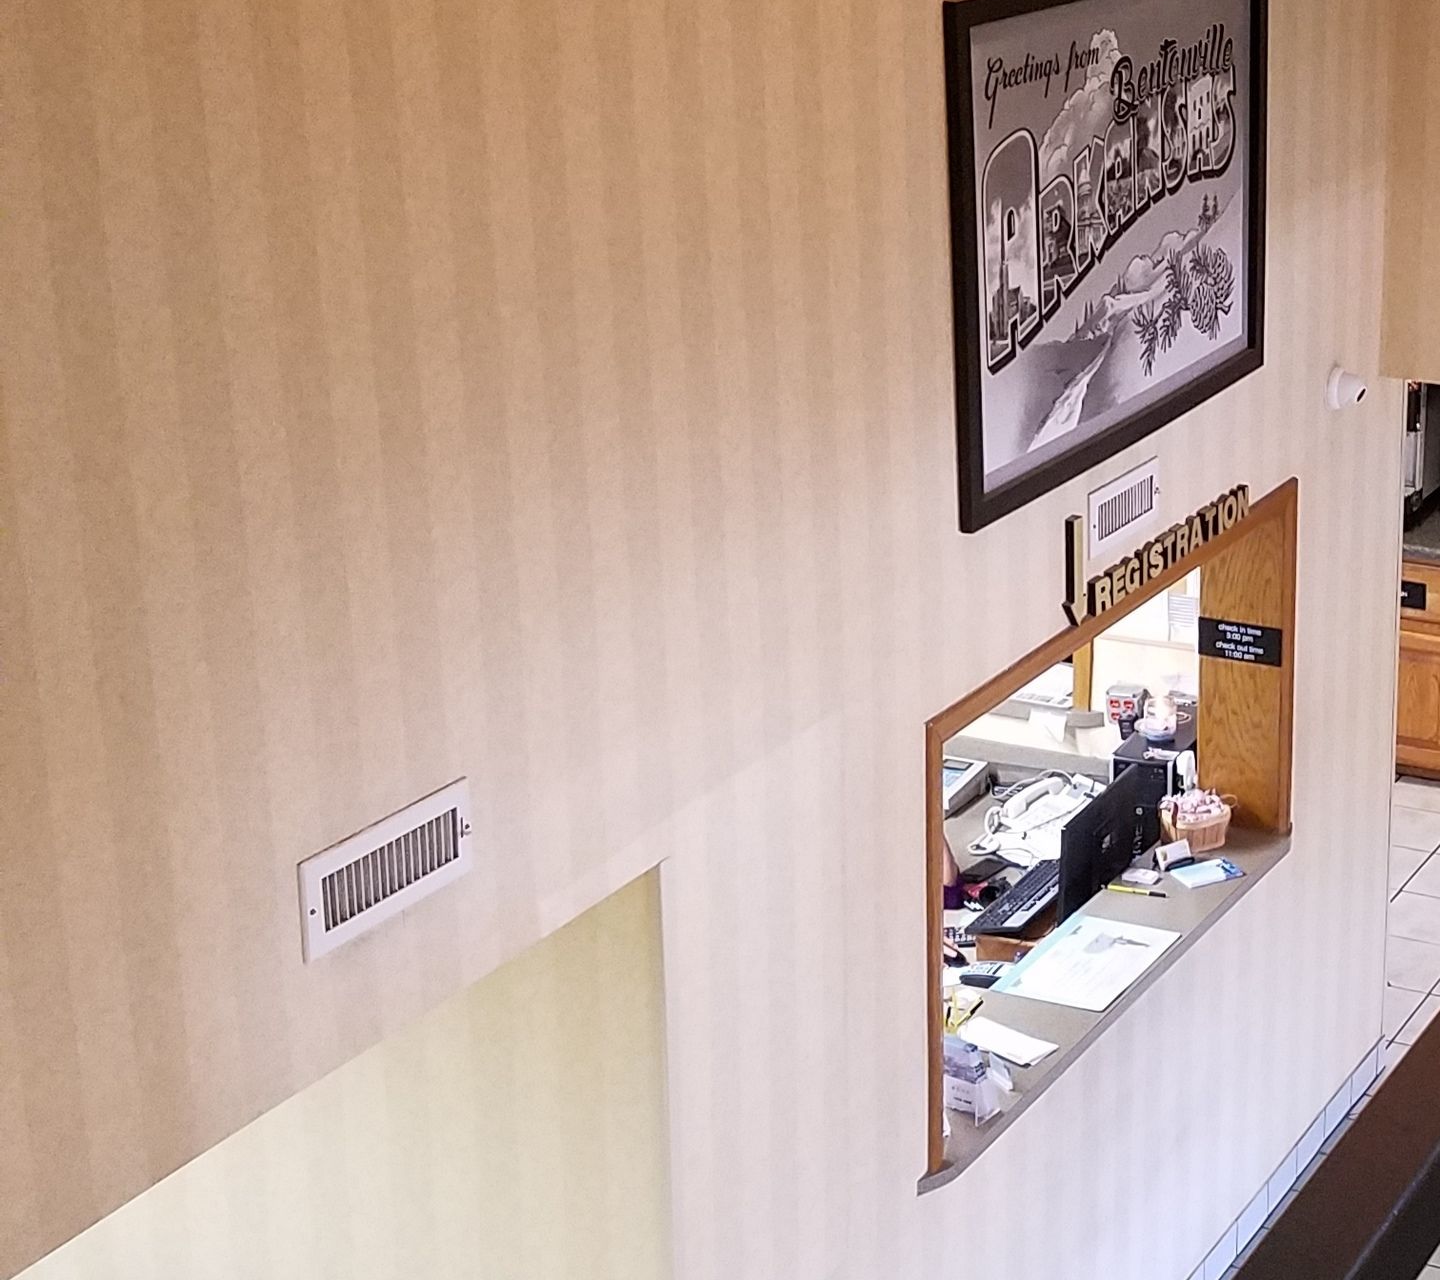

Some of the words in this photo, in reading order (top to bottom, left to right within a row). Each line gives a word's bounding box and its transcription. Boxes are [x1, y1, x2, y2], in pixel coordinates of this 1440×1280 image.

[985, 53, 1060, 129] Greetings
[1064, 41, 1101, 93] from
[1110, 24, 1234, 121] Bentonville
[982, 62, 1236, 375] ARKANSAS
[1088, 484, 1251, 617] REGISTRATION
[1215, 641, 1236, 650] check
[1249, 646, 1264, 654] time
[1218, 624, 1238, 632] check
[1247, 628, 1262, 636] time
[1225, 650, 1242, 659] 11:00
[1242, 635, 1253, 643] pm
